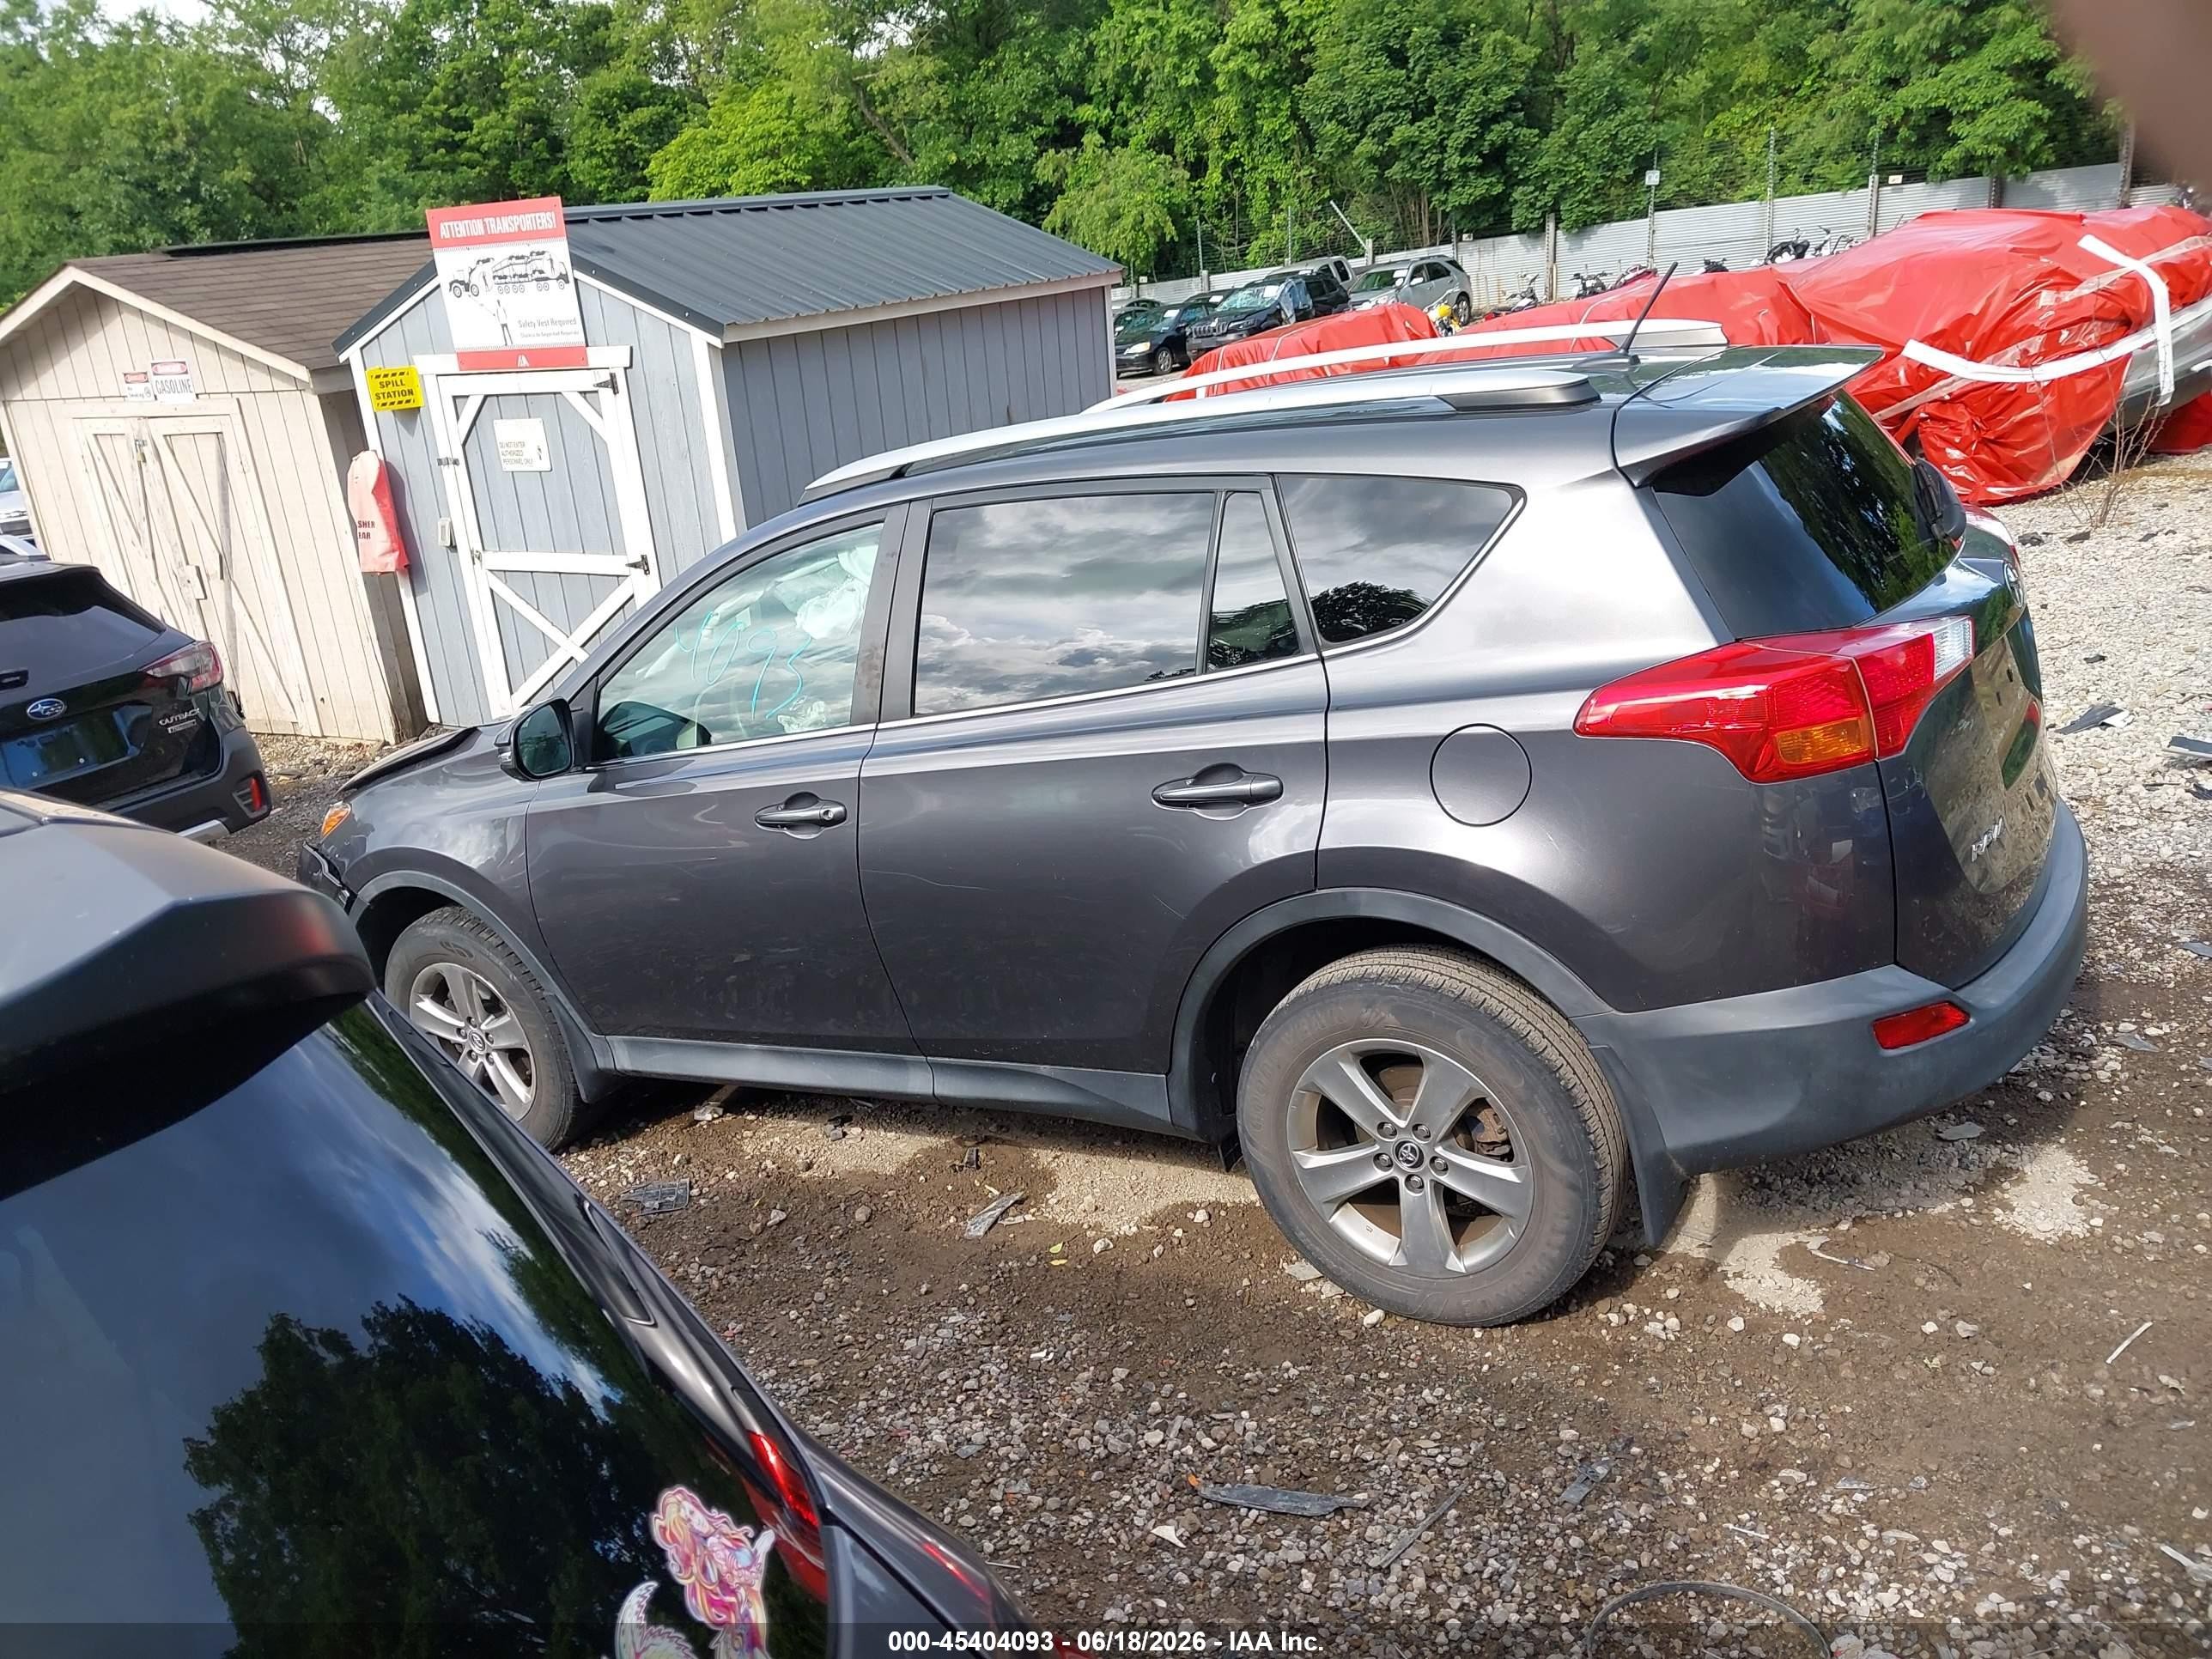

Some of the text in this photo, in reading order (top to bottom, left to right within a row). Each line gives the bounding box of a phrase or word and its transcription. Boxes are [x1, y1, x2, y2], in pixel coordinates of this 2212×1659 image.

[440, 211, 556, 239] ATTENTION TRANSPORTERS!
[518, 317, 577, 328] Safety Vest Required
[155, 379, 193, 395] GASOLINE
[379, 379, 405, 389] SPILL
[375, 388, 414, 400] STATION
[674, 611, 812, 721] 4093
